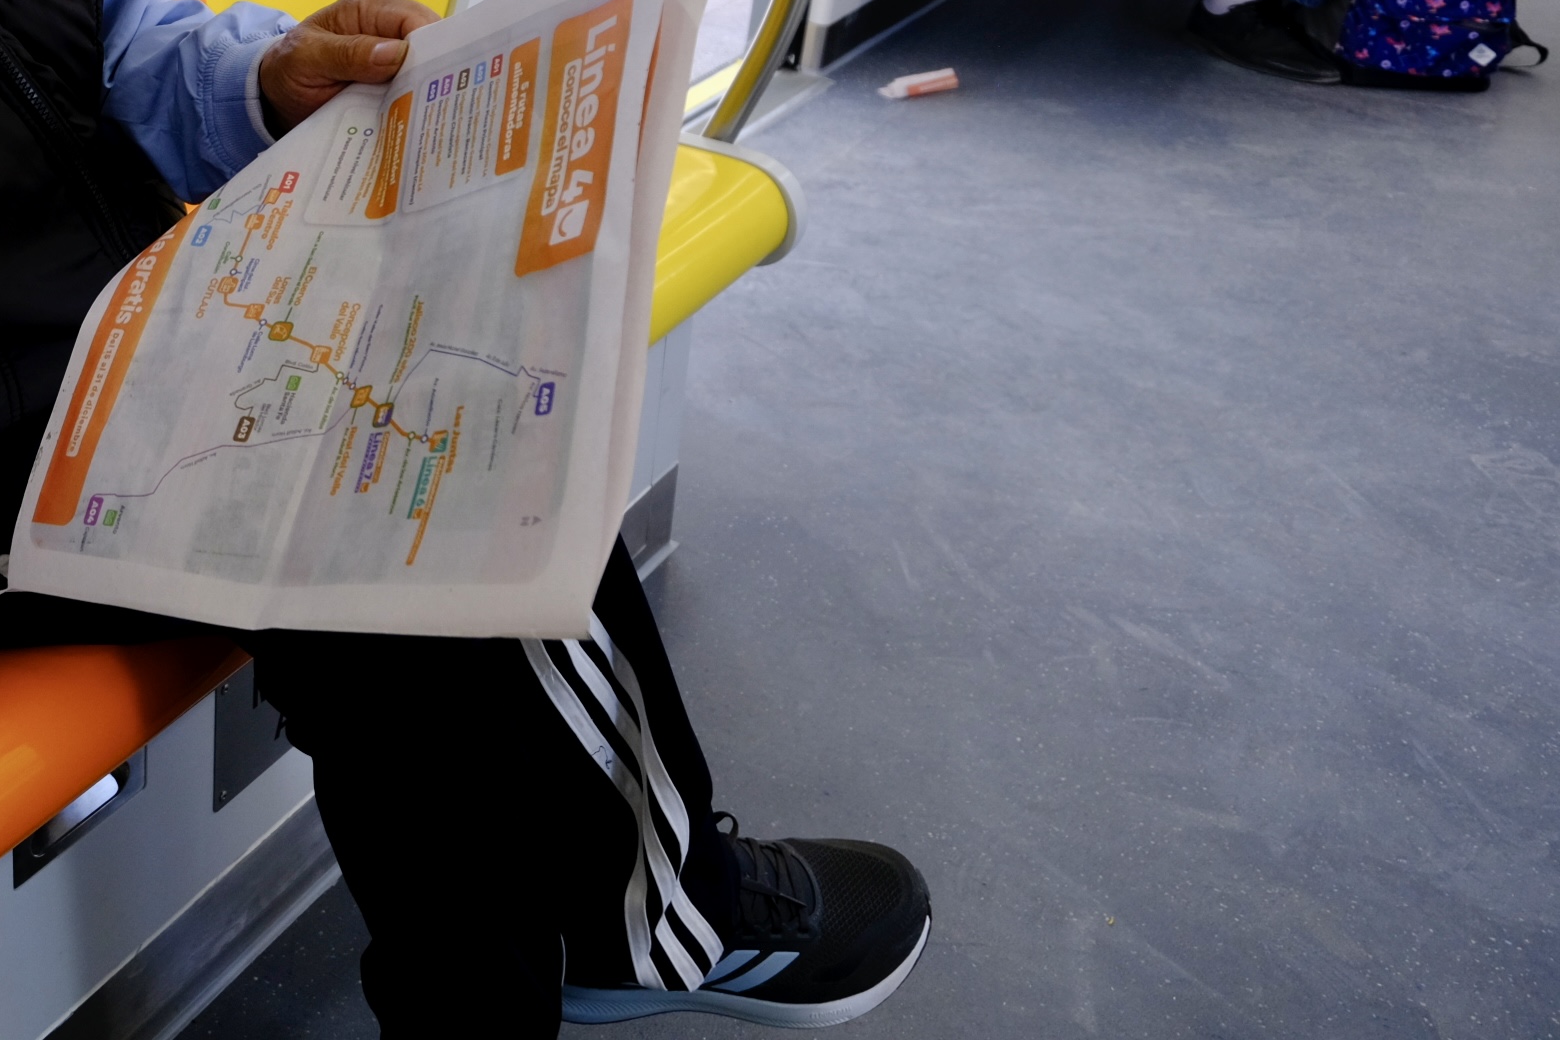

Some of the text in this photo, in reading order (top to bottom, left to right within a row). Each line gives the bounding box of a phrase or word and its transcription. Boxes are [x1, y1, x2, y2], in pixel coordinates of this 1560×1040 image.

[443, 77, 451, 95] A04
[460, 71, 468, 88] A03
[476, 65, 484, 82] A02
[503, 61, 524, 161] alimentadoras
[515, 80, 530, 129] 5 rutas
[561, 14, 618, 202] Línea 4
[358, 138, 369, 156] Cruce
[478, 129, 488, 161] Principal
[544, 64, 580, 209] conoce el mapa
[282, 173, 295, 189] A01
[322, 137, 353, 202] Paso superior vehicular
[350, 160, 360, 174] nivel
[338, 174, 356, 201] vehicular
[194, 228, 209, 245] A02
[260, 207, 280, 240] Centro
[265, 199, 294, 251] Tlajomulco
[115, 255, 157, 324] gratis
[195, 277, 219, 319] CUTLAJO
[265, 276, 282, 306] del Sur
[273, 276, 293, 305] Lomas
[293, 266, 318, 306] El Cuervo
[330, 301, 350, 340] del Valle
[333, 303, 361, 362] Concepción
[404, 337, 417, 358] 200
[393, 359, 409, 383] años
[69, 332, 120, 453] Del 15 al 31 de diciembre
[275, 391, 290, 420] Santa Fe
[279, 392, 296, 425] Hacienda
[539, 386, 551, 412] A05
[237, 419, 251, 439] A03
[445, 406, 465, 474] Las Juntas
[330, 426, 358, 496] Real del Valle
[366, 432, 383, 471] Línea
[363, 471, 373, 481] 7
[415, 455, 438, 508] Línea 6
[86, 500, 99, 524] A04
[112, 504, 126, 535] Arvento
